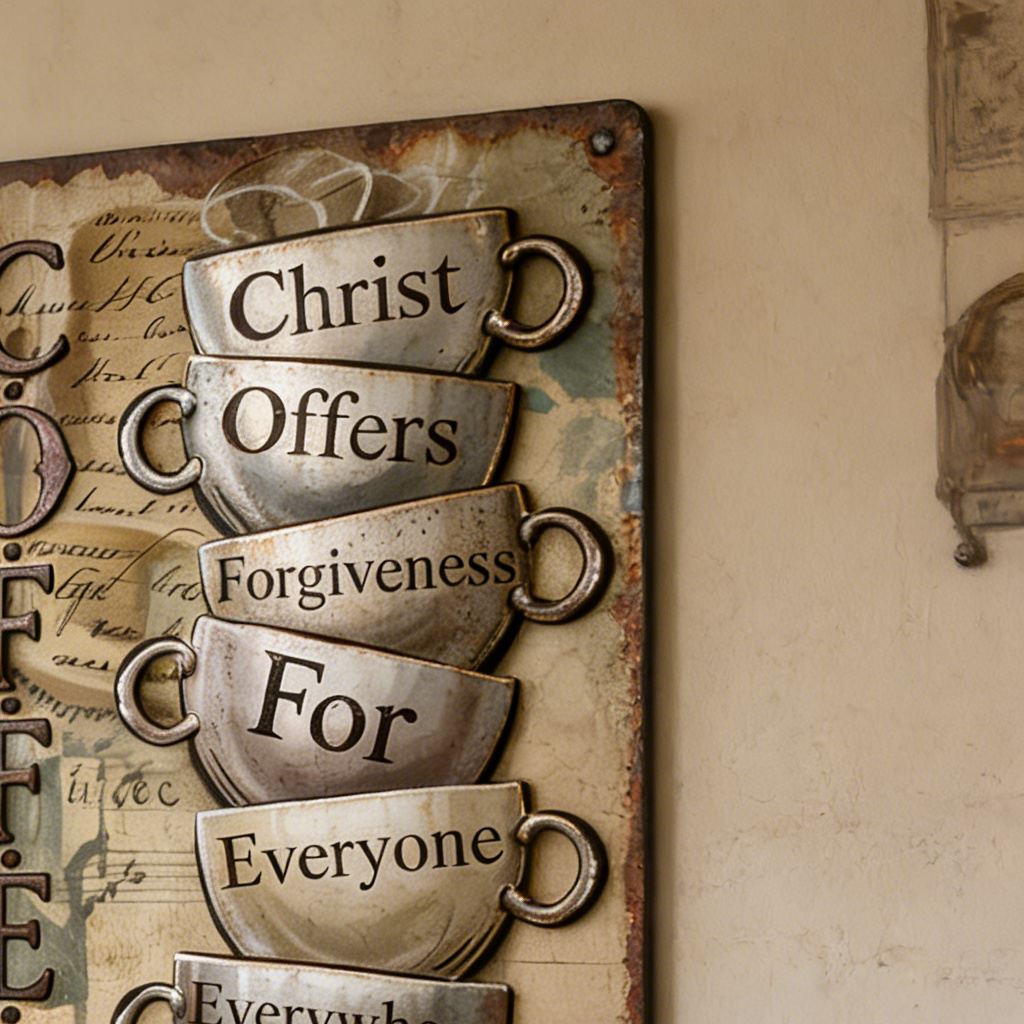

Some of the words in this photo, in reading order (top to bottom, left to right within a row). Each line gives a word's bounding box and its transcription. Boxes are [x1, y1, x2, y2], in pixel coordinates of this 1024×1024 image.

[229, 252, 469, 344] Christ
[220, 384, 460, 468] Offers
[217, 547, 519, 612] Forgiveness
[247, 649, 418, 765] For
[218, 824, 505, 892] Everyone
